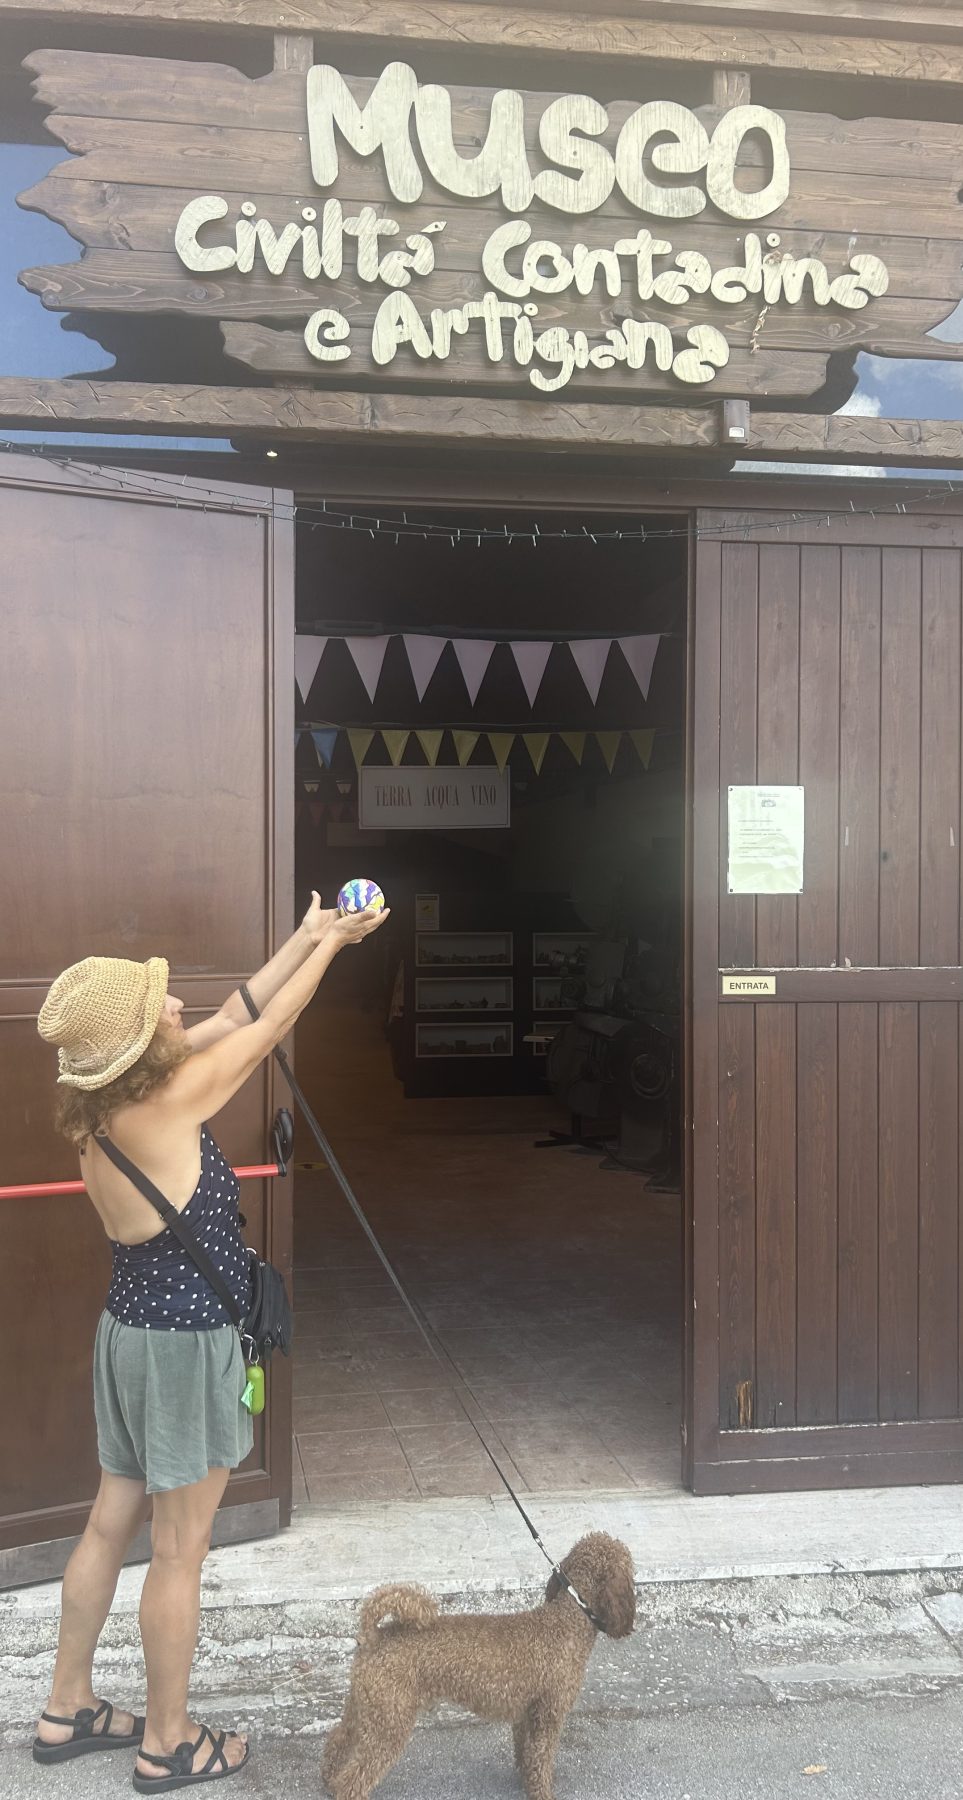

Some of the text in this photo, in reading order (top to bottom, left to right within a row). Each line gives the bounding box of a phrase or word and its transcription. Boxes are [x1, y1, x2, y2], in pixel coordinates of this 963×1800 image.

[306, 61, 791, 220] Museo
[481, 219, 890, 310] Contadina
[303, 289, 731, 392] e Artigiana
[374, 784, 497, 809] TERRA ACQUA VINO
[729, 982, 769, 990] ENTRATA
